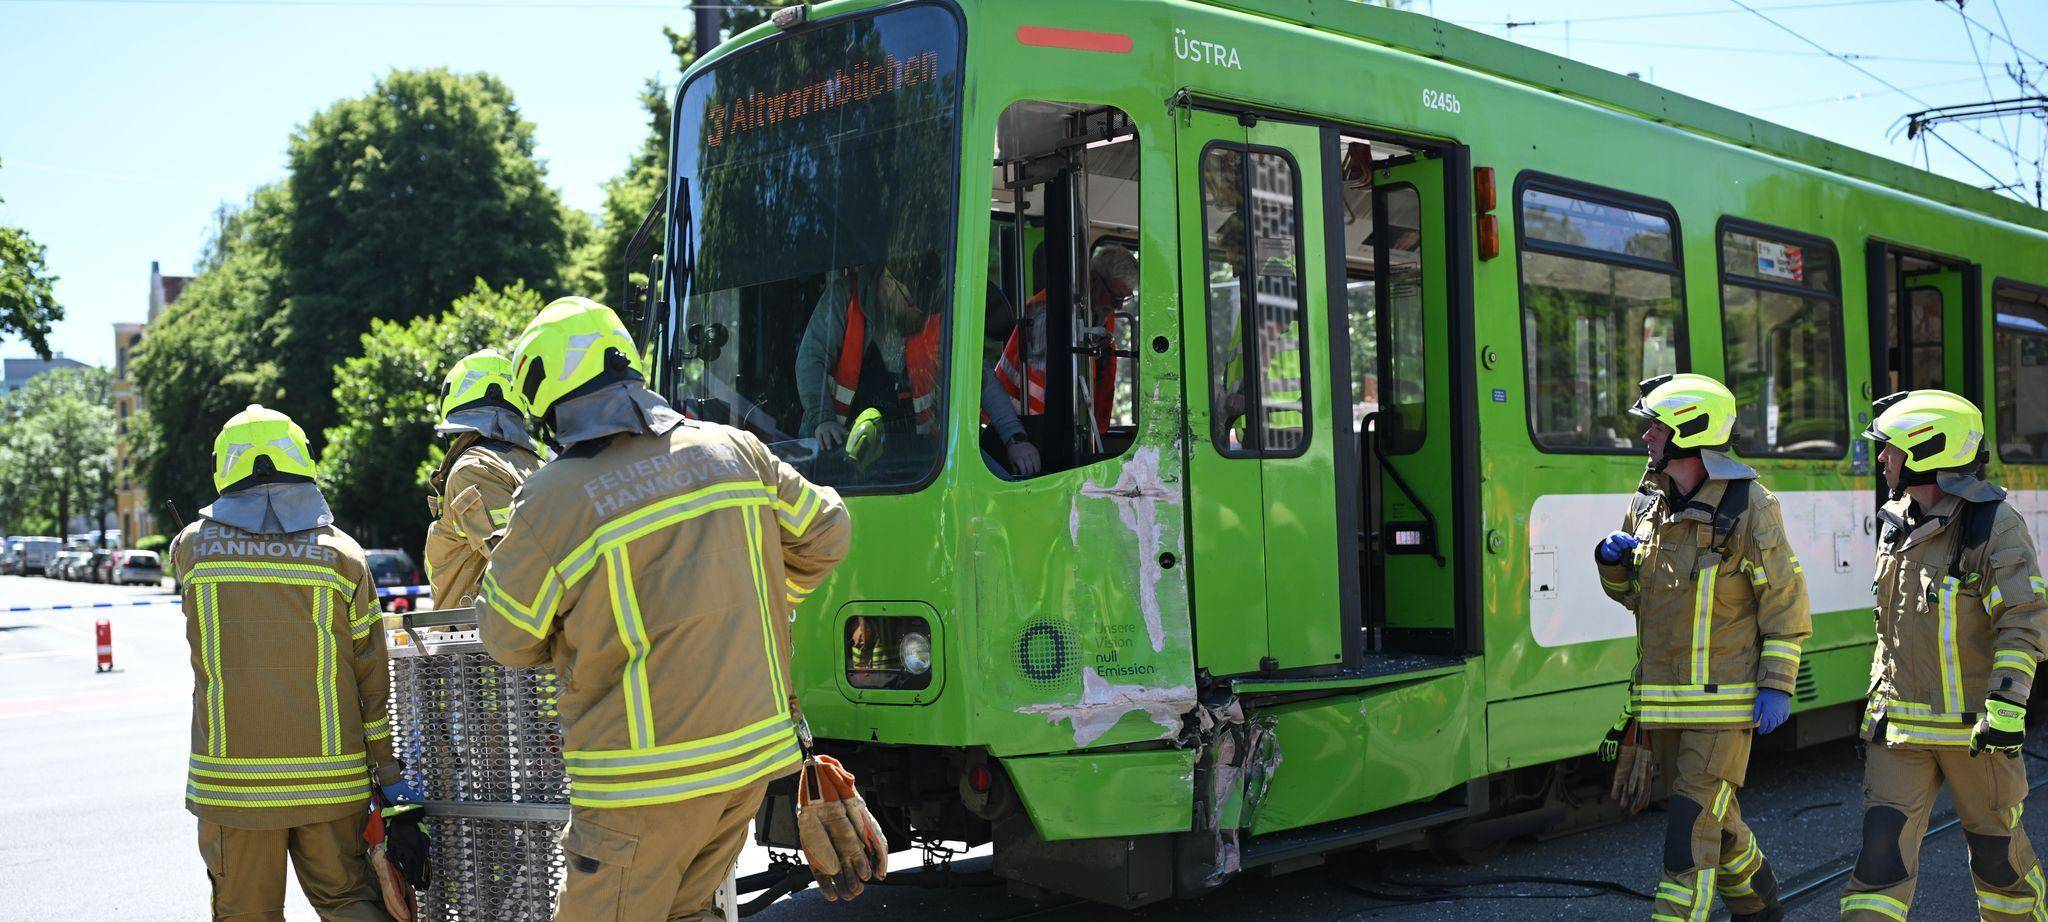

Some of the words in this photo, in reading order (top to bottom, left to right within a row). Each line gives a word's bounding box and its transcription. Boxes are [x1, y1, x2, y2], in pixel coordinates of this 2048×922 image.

[1174, 27, 1242, 70] ÜSTRA
[707, 104, 726, 148] 3
[731, 49, 939, 135] Altwarmbüchen
[1422, 88, 1461, 114] 6245b
[193, 540, 338, 563] HANNOVER
[1095, 622, 1136, 634] Unsere
[1095, 635, 1133, 648] Vision
[1096, 650, 1117, 663] null
[1097, 663, 1155, 677] Emission
